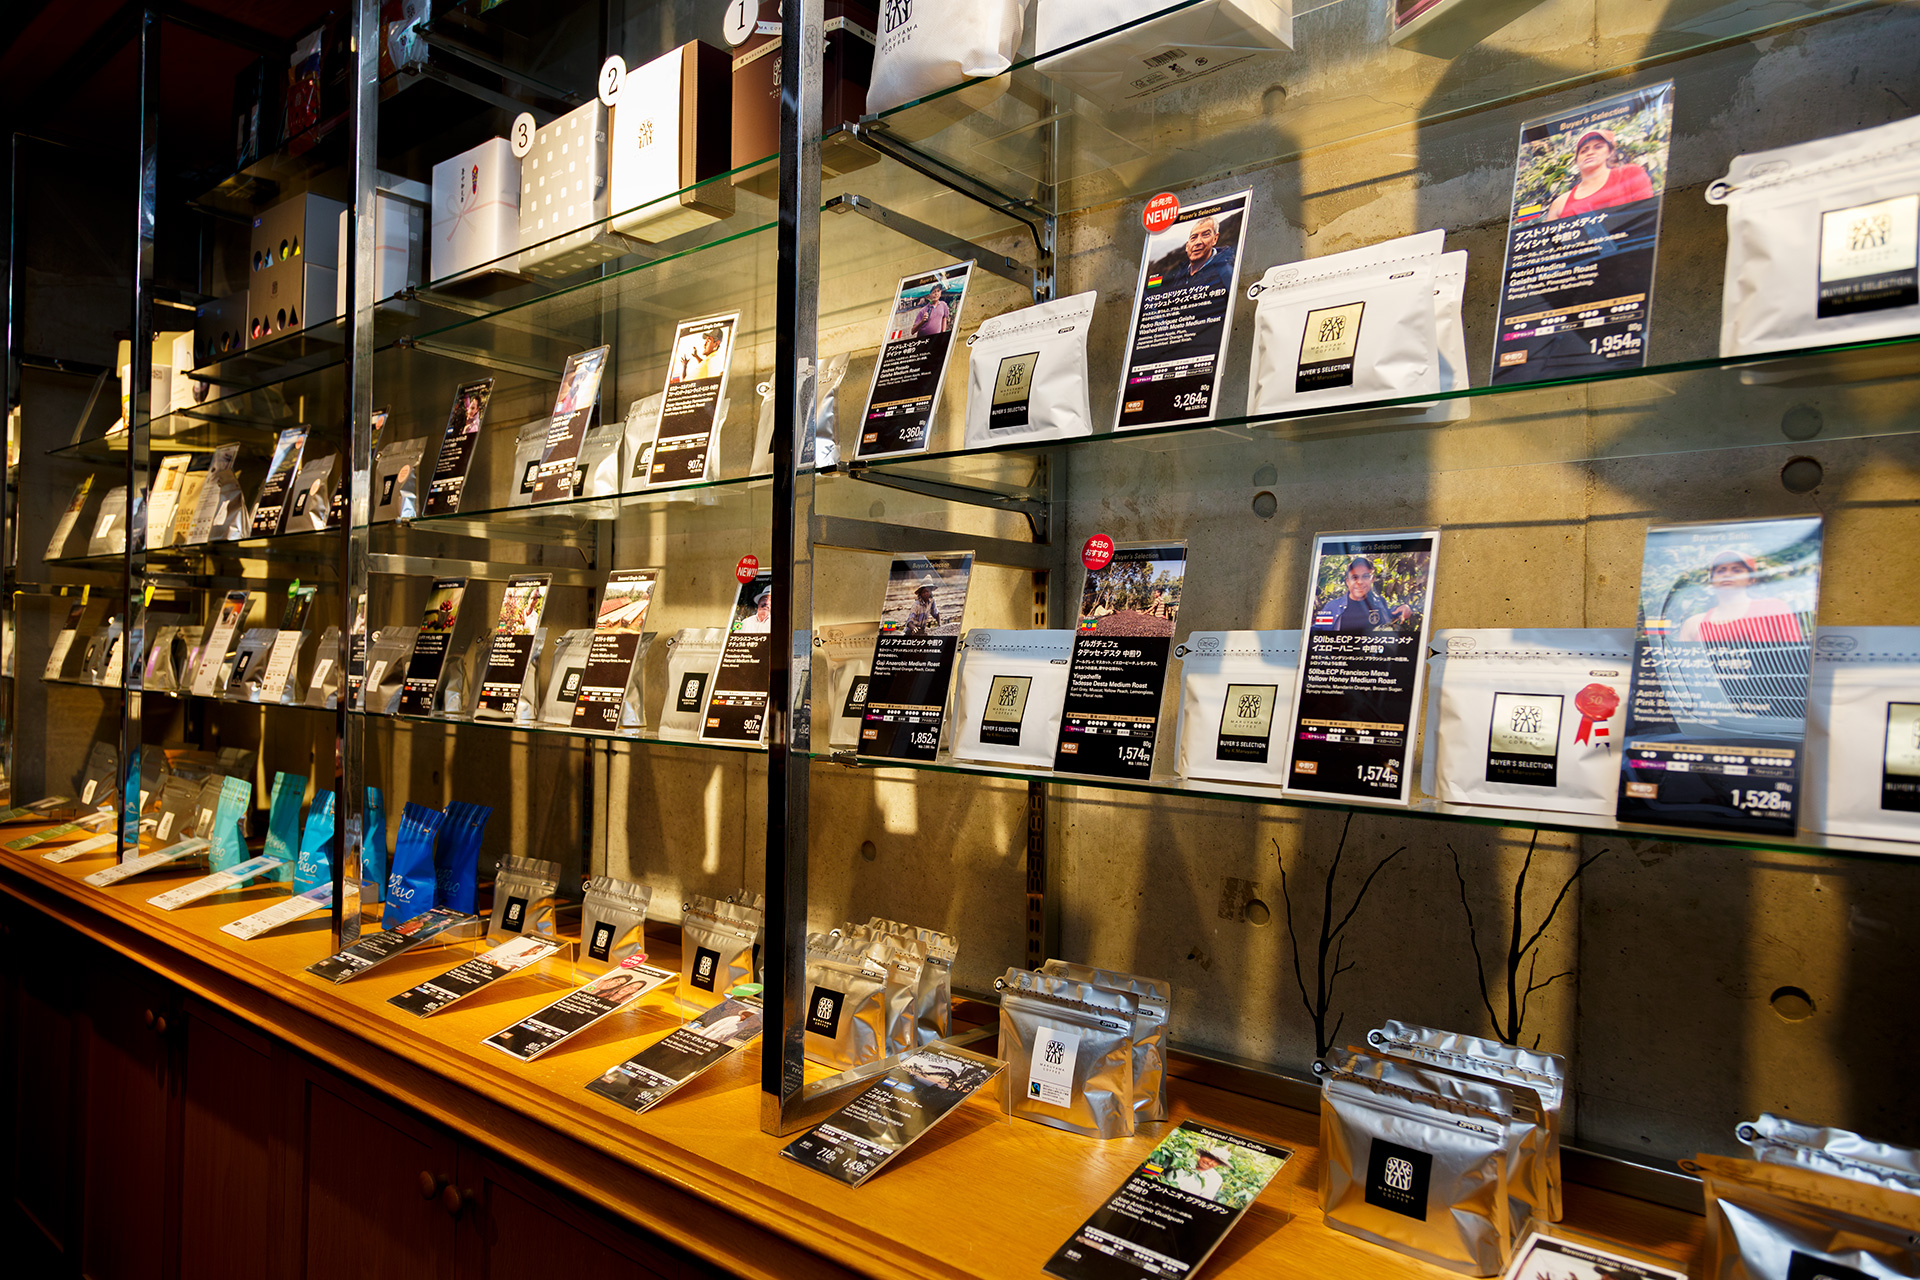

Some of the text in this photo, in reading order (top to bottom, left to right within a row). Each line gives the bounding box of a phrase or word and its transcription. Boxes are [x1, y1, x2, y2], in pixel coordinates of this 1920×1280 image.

[737, 1, 746, 30] 1
[881, 24, 918, 51] MARUYAMA
[884, 34, 911, 55] COFFEE
[608, 67, 619, 96] 2
[1559, 105, 1630, 131] Buyer's Selection
[518, 123, 528, 148] 3
[1150, 196, 1173, 209] 新発売
[1145, 205, 1178, 226] NEW!!
[1197, 206, 1222, 217] Selection
[1515, 213, 1608, 242] アストリッド・メディナ
[1513, 229, 1581, 252] ゲイシャ 中煎り
[1509, 263, 1599, 288] Geisha Medium Roast
[1510, 261, 1567, 279] Astrid Medina
[1589, 332, 1642, 355] 1,954円
[1299, 363, 1351, 377] BUYER'S SELECTION
[1173, 391, 1208, 409] 3,264円
[1007, 405, 1027, 413] SELECTION
[899, 425, 924, 441] 2,360円
[687, 459, 703, 470] 907円
[1091, 540, 1109, 549] 本日の
[1373, 543, 1402, 551] Selection
[1085, 548, 1109, 559] おすすめ
[737, 566, 757, 578] NEW!!
[1079, 640, 1119, 648] イルガチェフェ
[1313, 635, 1414, 645] 50lbs.ECP フランシスコ・メナ
[1077, 649, 1142, 658] タデッセ・デスタ 中煎り
[1362, 645, 1385, 654] 中煎り
[1339, 668, 1370, 676] Francisco
[1370, 669, 1389, 677] Mena
[1328, 675, 1349, 684] Honey
[1350, 676, 1377, 684] Medium
[1377, 677, 1397, 685] Roast
[1636, 689, 1702, 700] Astrid Medina
[1635, 698, 1656, 708] Pink
[1657, 699, 1699, 710] Bourbon
[743, 719, 760, 731] 907円
[998, 725, 1019, 733] SELECTION
[910, 732, 936, 745] 1,852円
[1142, 740, 1152, 748] 80g
[1240, 741, 1266, 749] SELECTION
[1118, 746, 1150, 761] 1,574円
[1388, 758, 1400, 768] 80g
[1490, 758, 1554, 770] BUYER'S SELECTION
[1357, 765, 1398, 783] 1,574円
[1730, 789, 1792, 812] 1,528円
[1101, 1020, 1117, 1029] ZIPPER
[1458, 1121, 1483, 1132] ZIPPER
[1200, 1128, 1267, 1153] Seasonal Single Coffee
[816, 1146, 837, 1162] 718円
[842, 1158, 868, 1175] 1,436円
[1132, 1177, 1229, 1215] ホセ・アントニオ・グアルグアン
[1378, 1185, 1415, 1201] MARUYAMA
[1383, 1192, 1409, 1204] COFFEE
[1111, 1199, 1144, 1215] Dark Roast
[1130, 1201, 1154, 1214] Antonio
